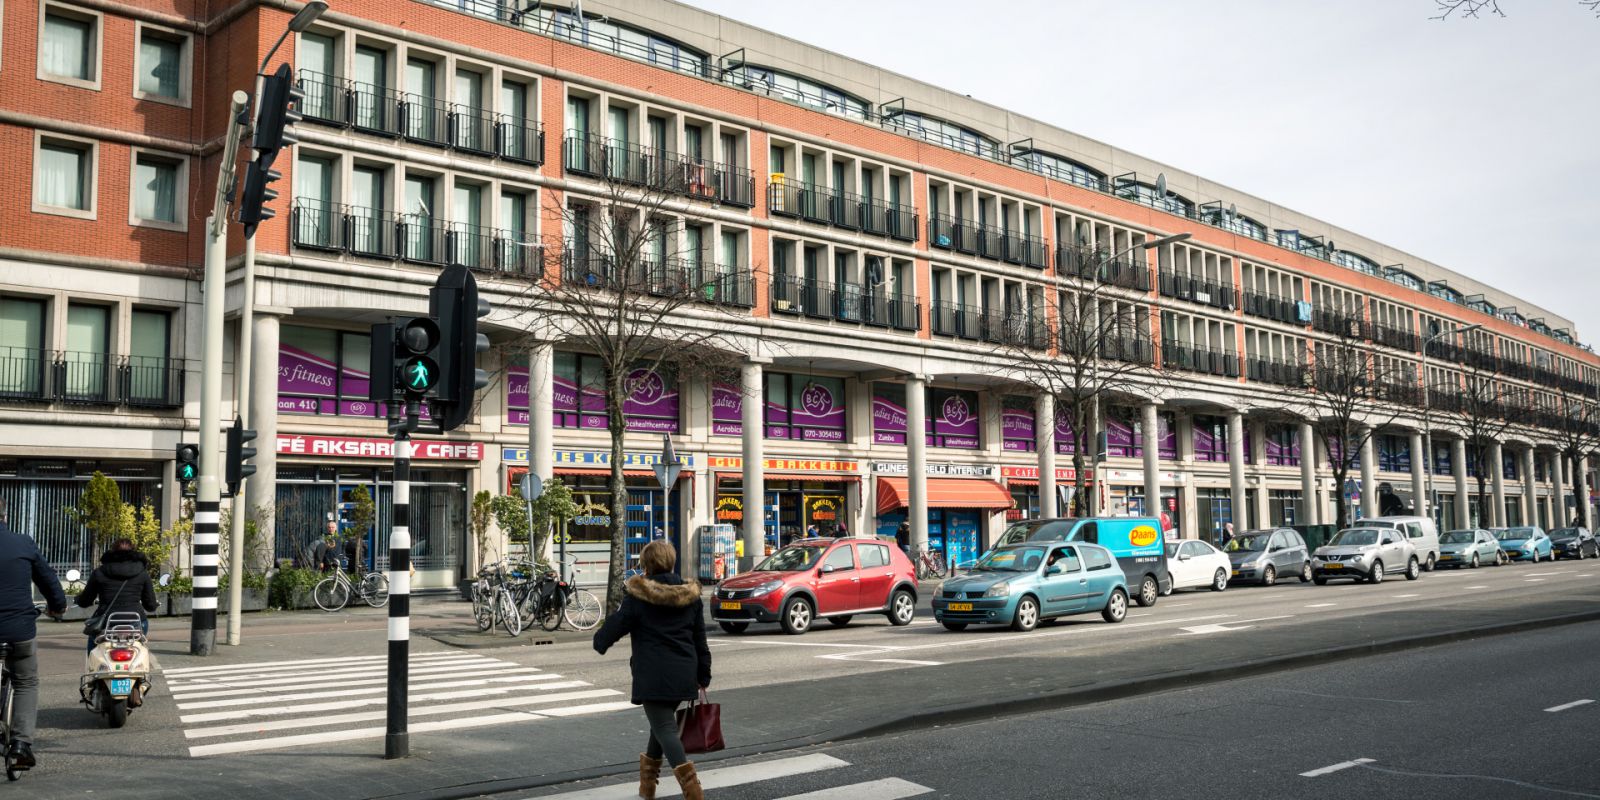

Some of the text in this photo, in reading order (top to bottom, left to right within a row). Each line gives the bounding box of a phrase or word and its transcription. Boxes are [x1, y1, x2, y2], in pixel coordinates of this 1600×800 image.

[288, 364, 333, 386] fitness
[299, 400, 317, 409] 410
[426, 443, 478, 458] CAFÉ
[776, 459, 853, 471] BAKKERIJ
[948, 466, 988, 475] INTERNET
[1015, 467, 1037, 477] CAFÉ
